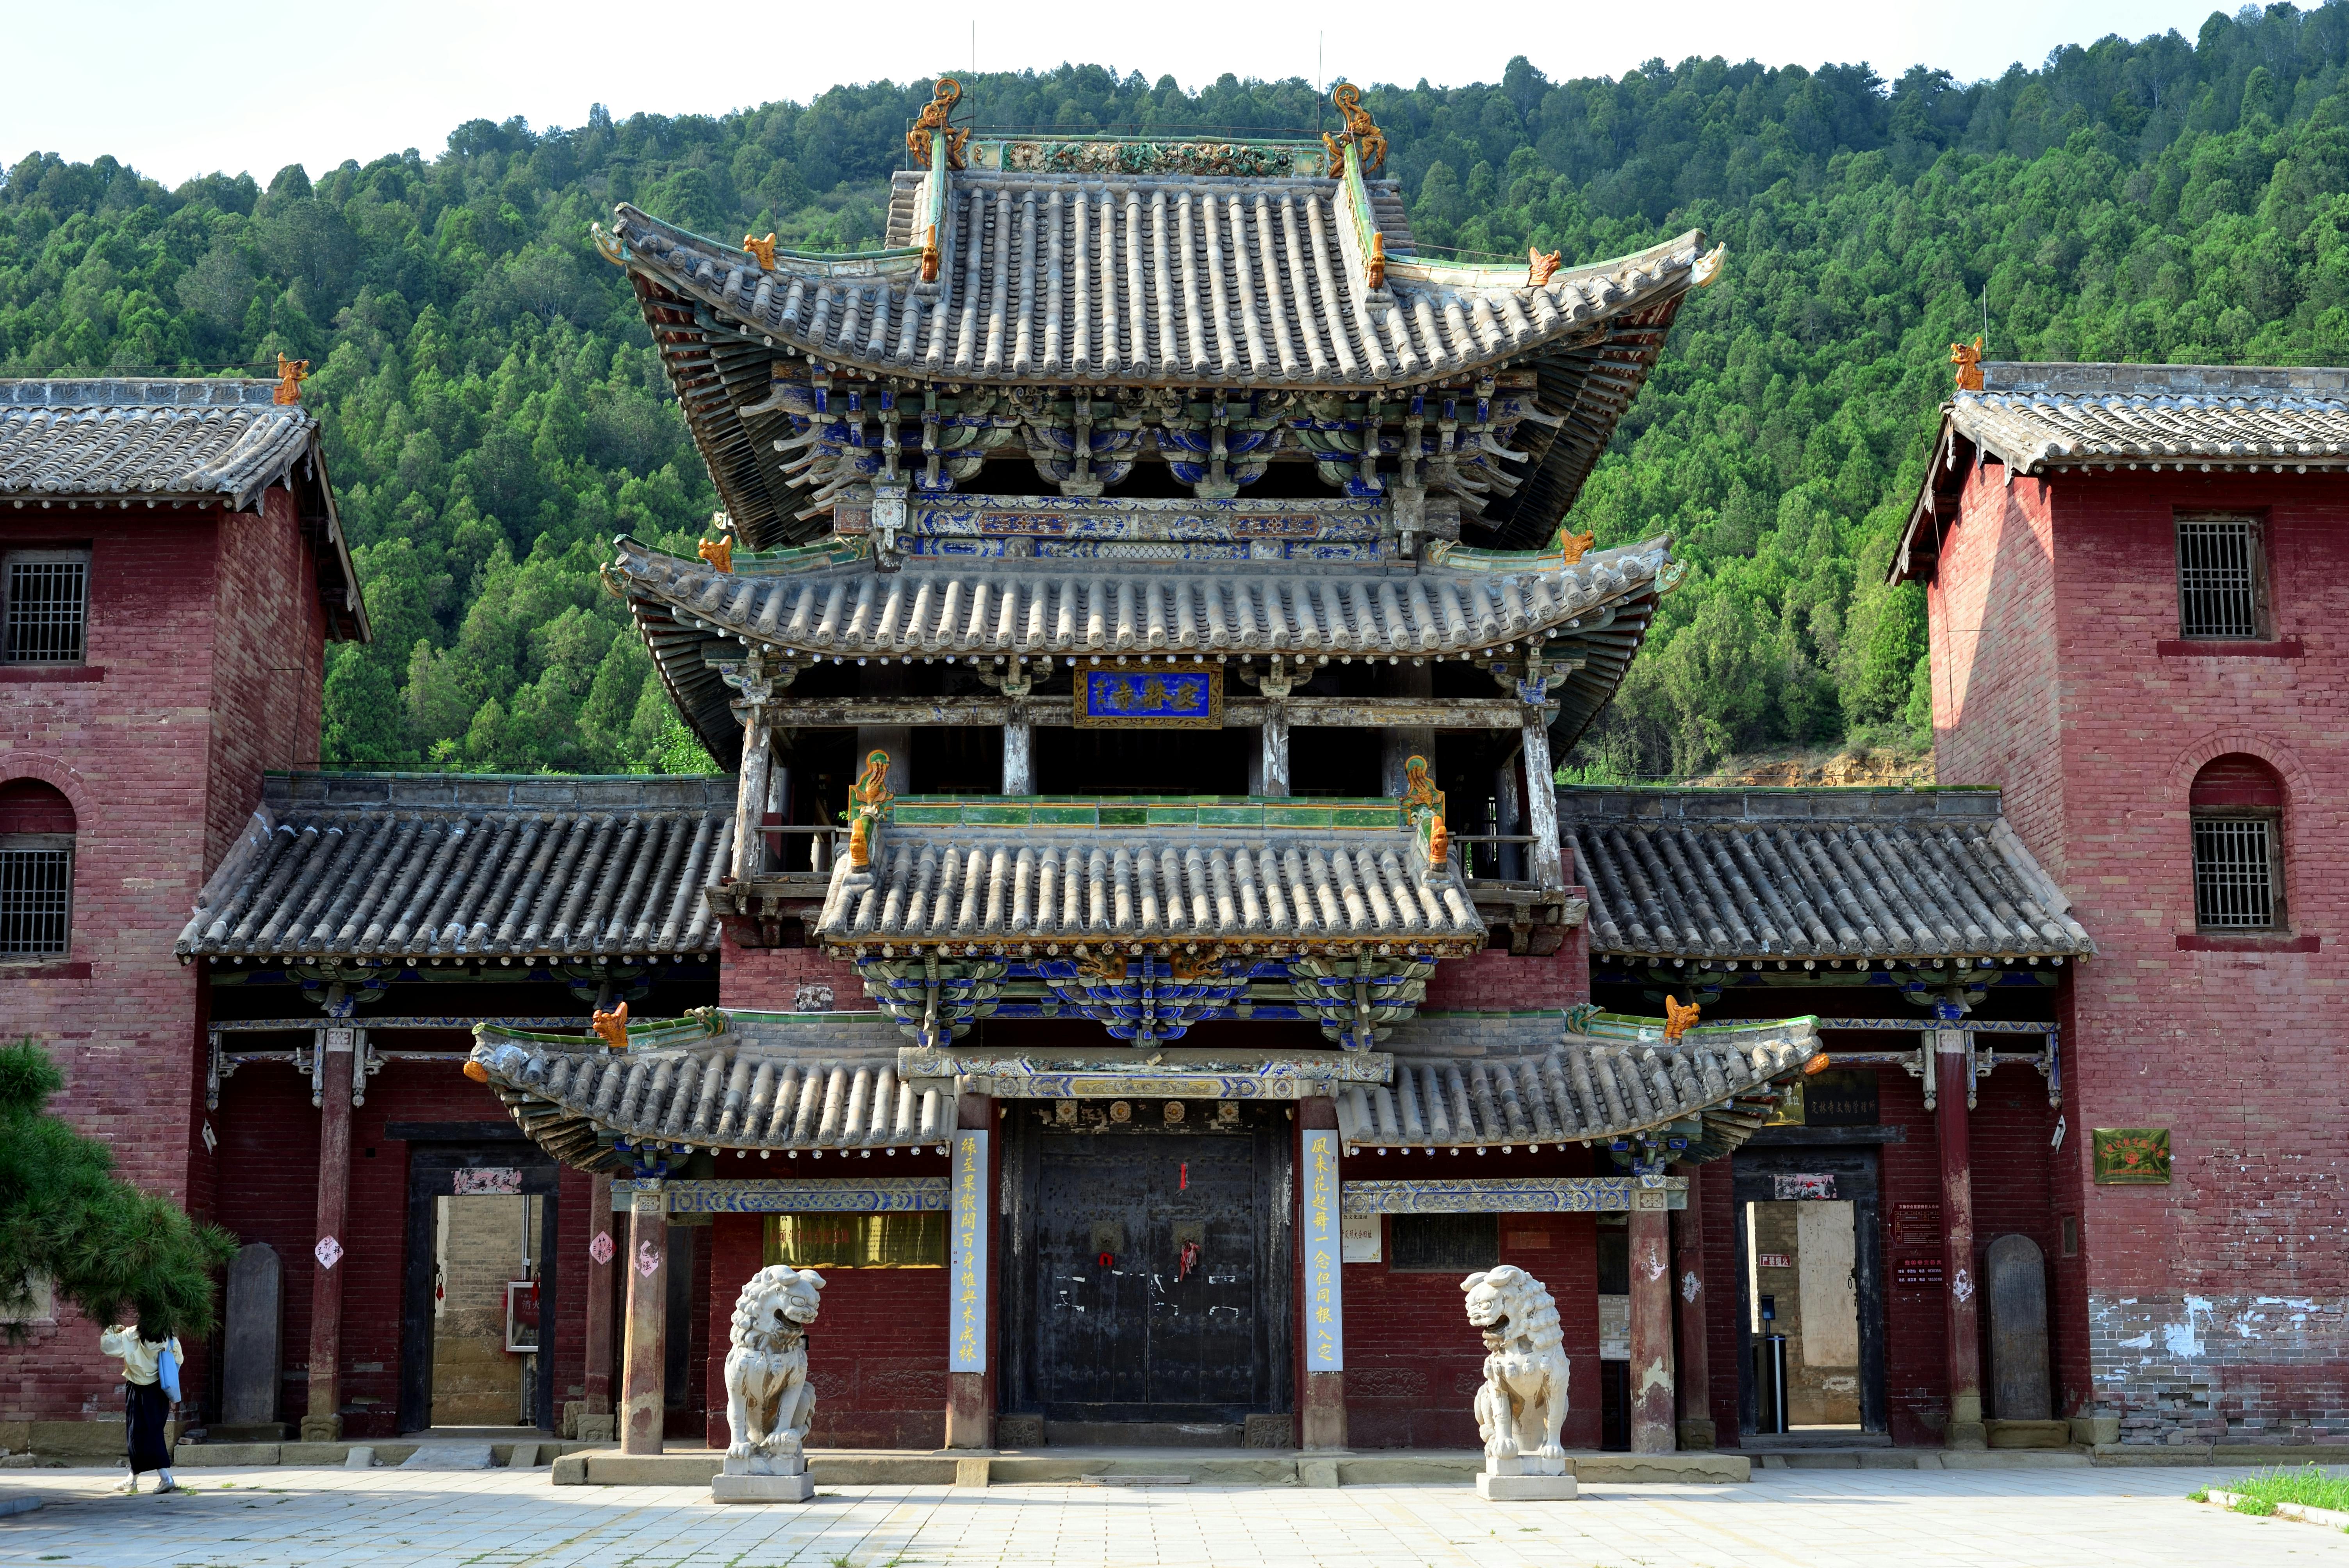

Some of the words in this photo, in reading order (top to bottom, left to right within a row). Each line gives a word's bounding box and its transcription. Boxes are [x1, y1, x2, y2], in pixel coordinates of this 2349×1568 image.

[1786, 1095, 1800, 1106] 单位
[1811, 1100, 1876, 1115] 定林寺文物管理所
[1763, 1256, 1788, 1265] 严禁烟火
